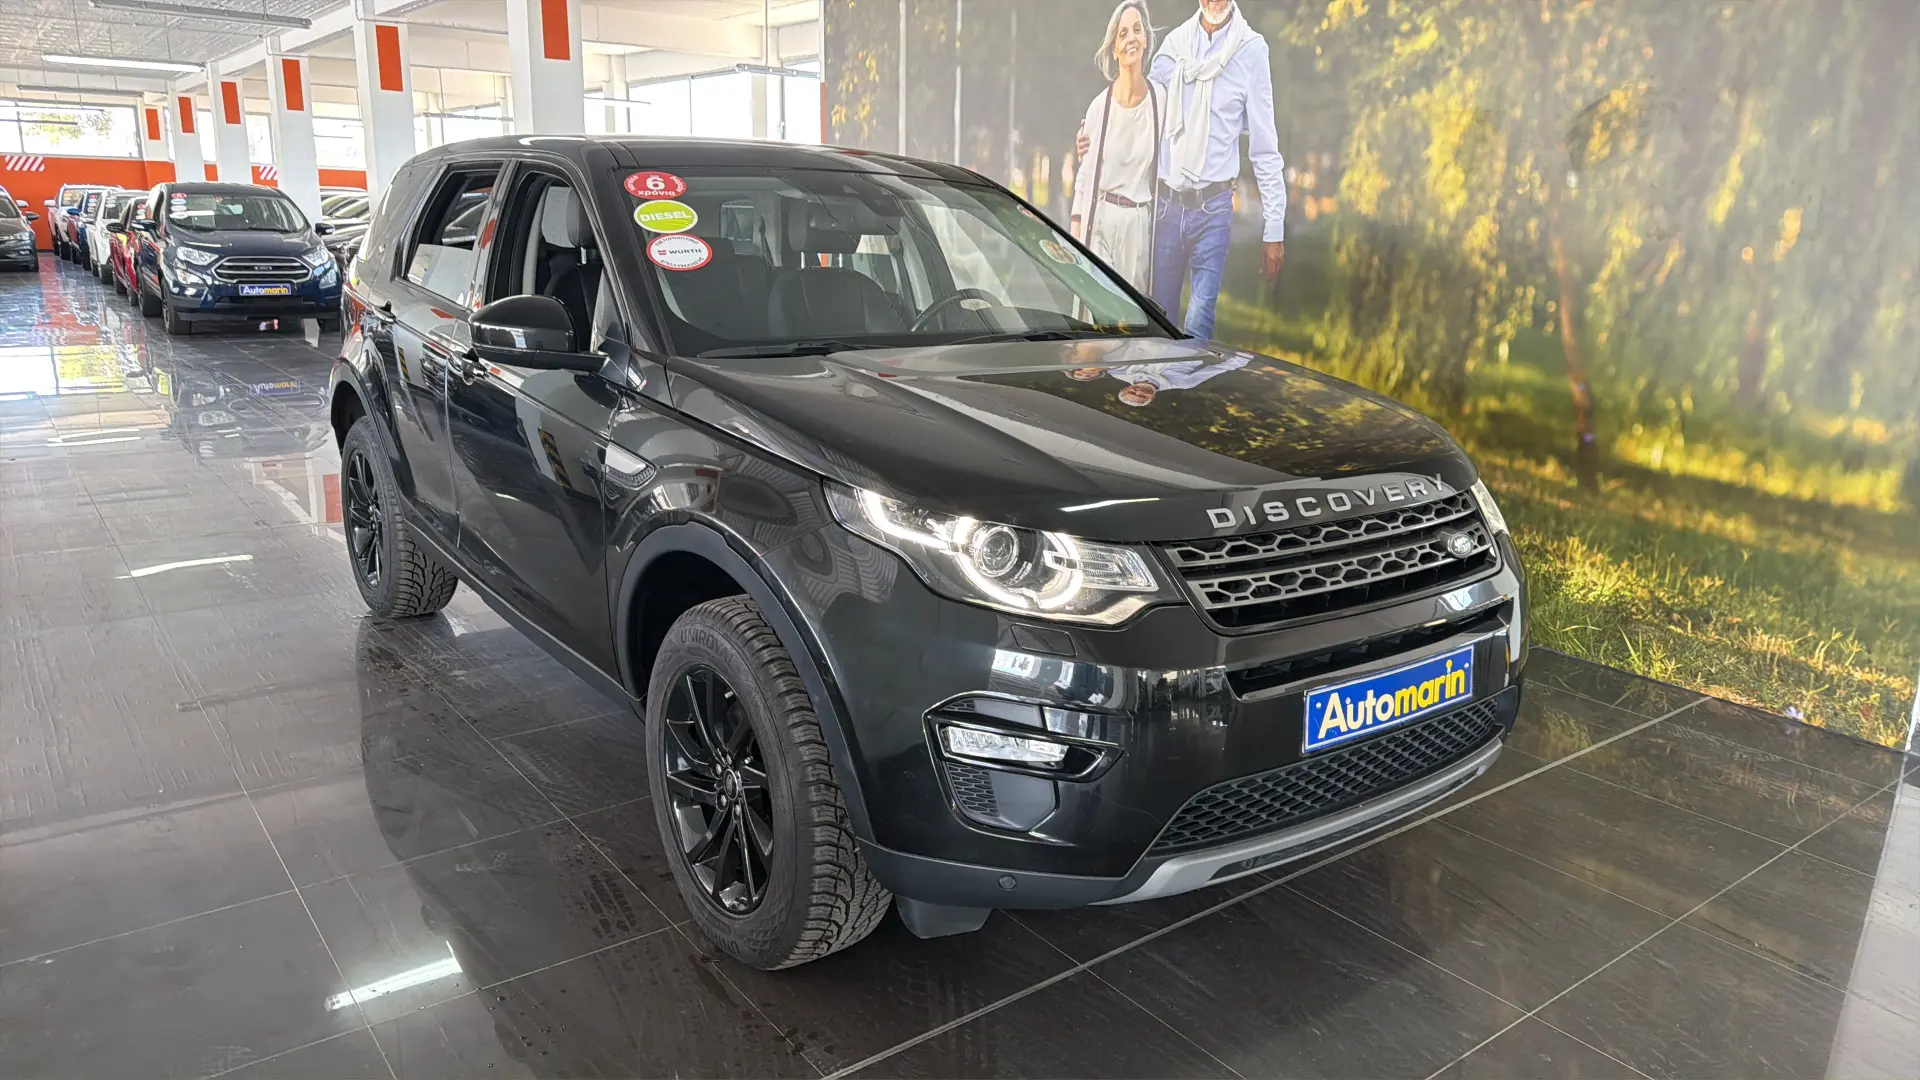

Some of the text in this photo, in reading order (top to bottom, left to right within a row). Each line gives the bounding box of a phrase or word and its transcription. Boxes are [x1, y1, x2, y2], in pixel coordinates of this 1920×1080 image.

[646, 177, 665, 190] 6
[640, 211, 692, 222] DIESEL
[242, 284, 289, 295] Automarin
[1206, 473, 1444, 529] DISCOVERY
[1317, 659, 1466, 739] Automarin
